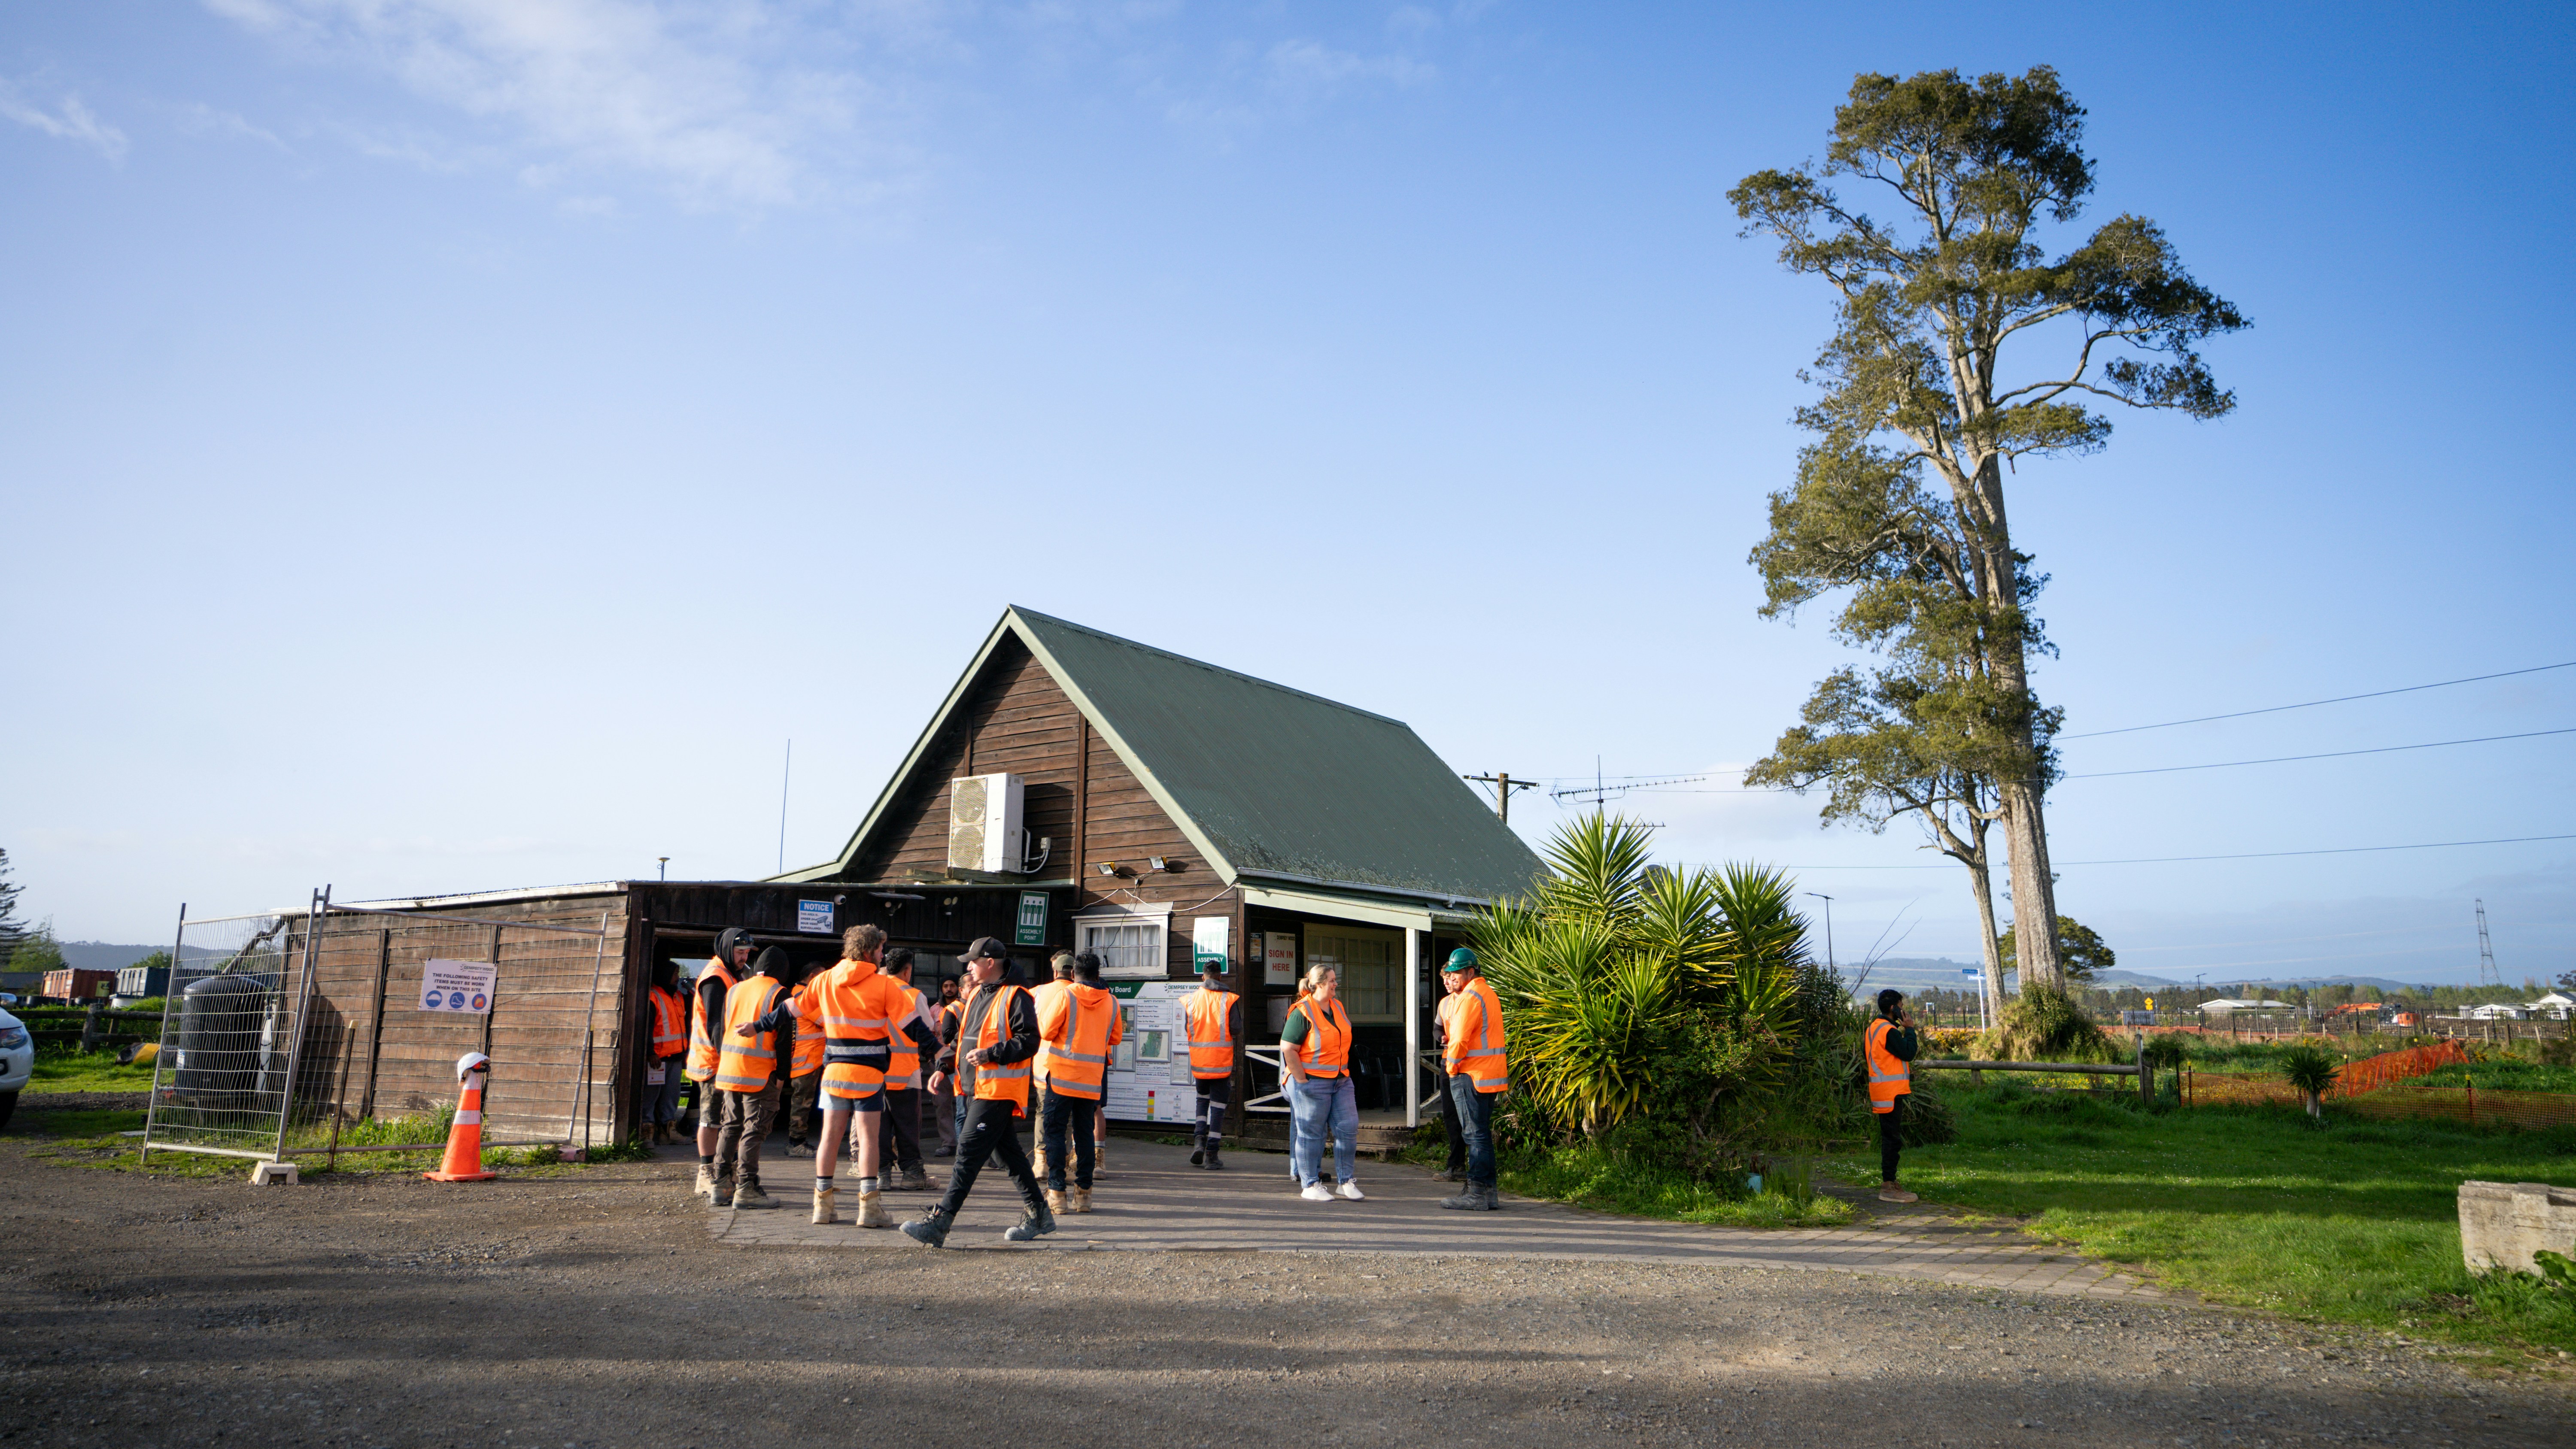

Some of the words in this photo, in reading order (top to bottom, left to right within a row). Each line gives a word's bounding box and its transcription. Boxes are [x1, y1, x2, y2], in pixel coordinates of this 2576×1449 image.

[804, 903, 829, 911] NOTICE
[1268, 949, 1285, 958] SIGN
[1286, 950, 1293, 958] IN
[1272, 963, 1290, 971] HERE
